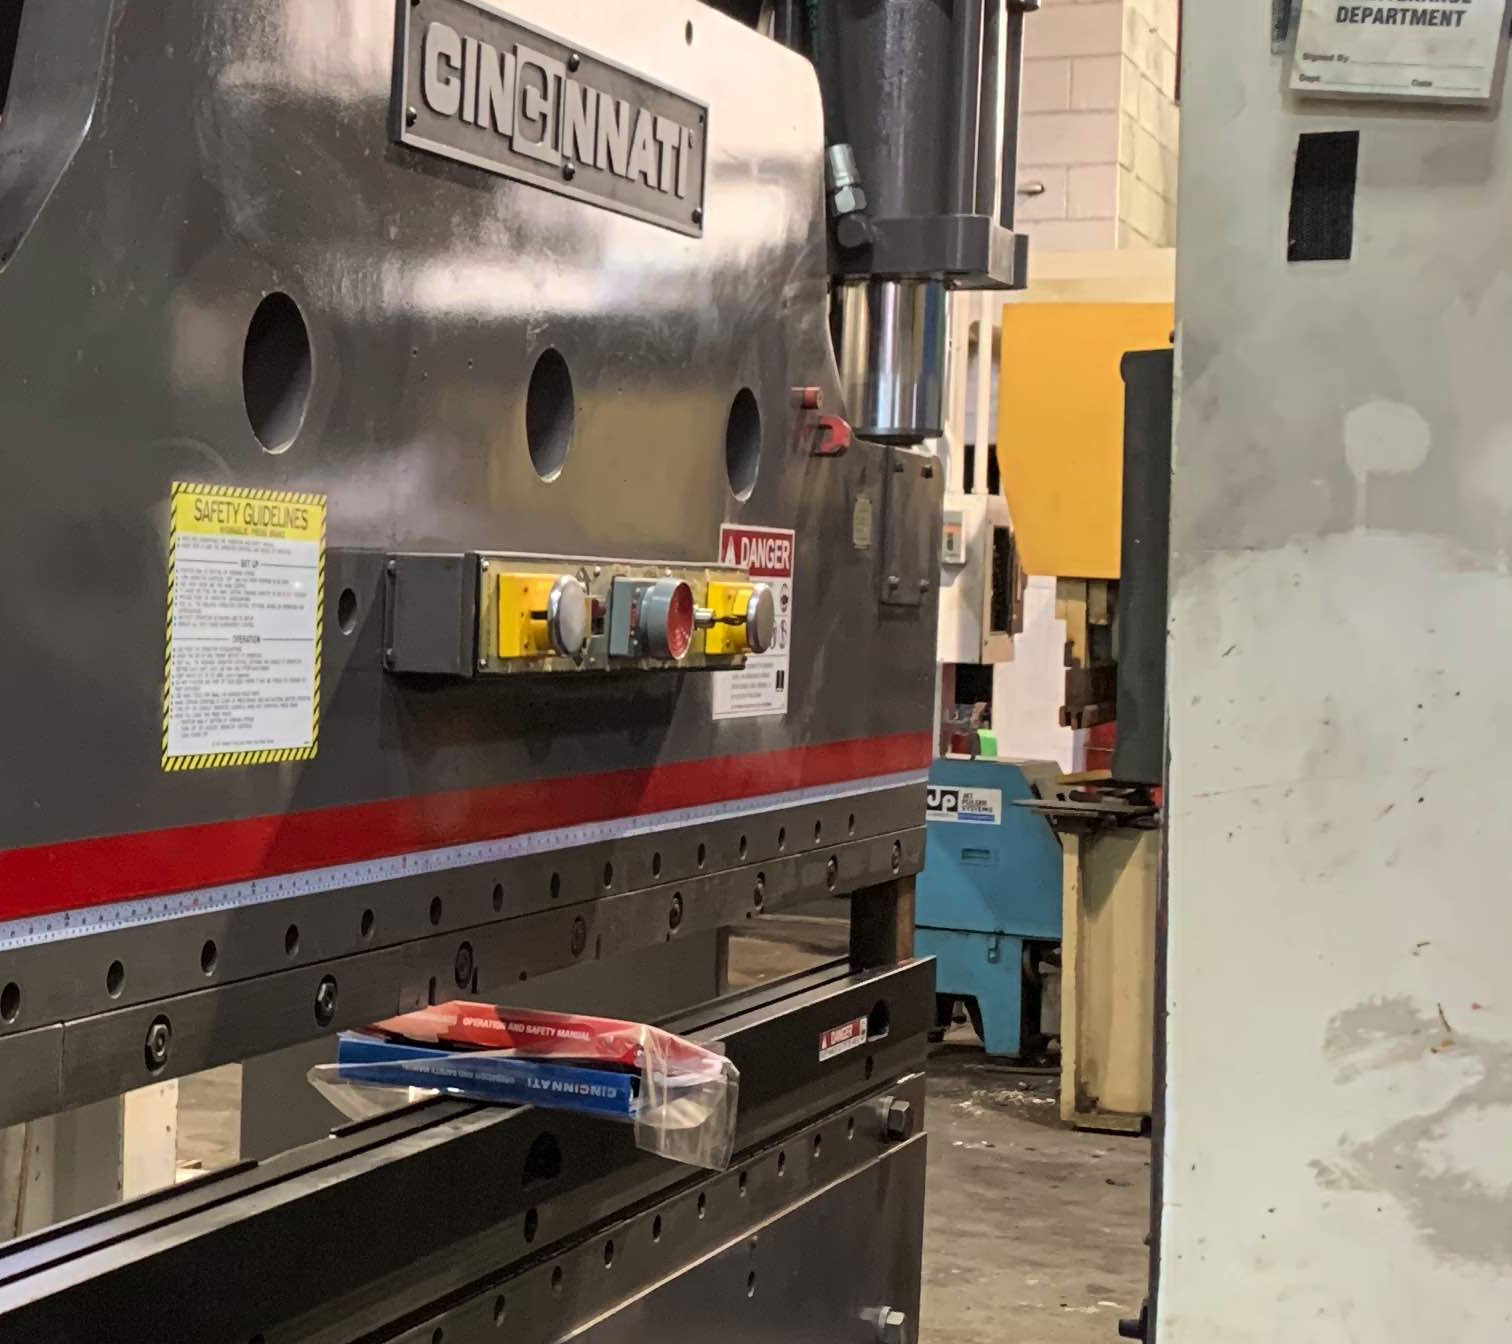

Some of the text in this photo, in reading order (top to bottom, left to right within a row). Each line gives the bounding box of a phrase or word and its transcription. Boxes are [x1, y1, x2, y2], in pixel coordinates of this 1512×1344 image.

[1336, 6, 1467, 28] DEPARTMENT
[424, 22, 692, 199] CINCINNATI
[194, 498, 310, 531] SAFETY GUIDELINES
[740, 536, 791, 570] DANGER
[526, 1024, 556, 1037] SAFETY
